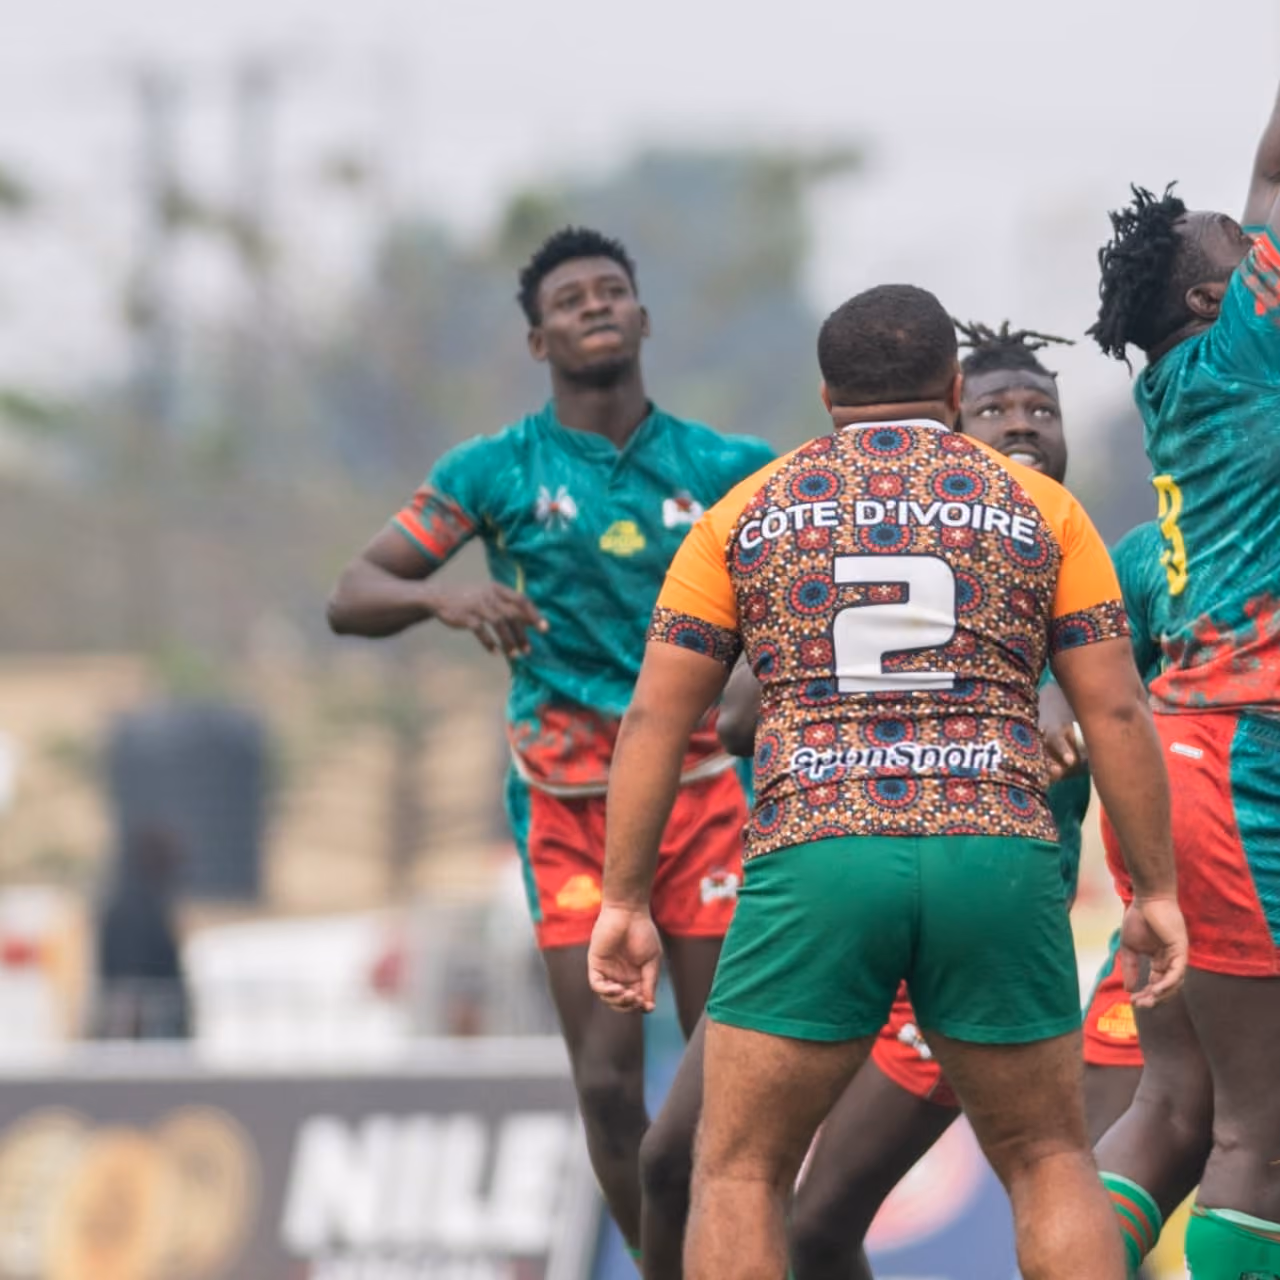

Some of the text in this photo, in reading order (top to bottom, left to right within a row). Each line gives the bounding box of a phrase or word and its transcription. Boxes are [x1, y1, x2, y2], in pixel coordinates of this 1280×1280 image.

[739, 500, 1038, 550] CÔTE D'IVOIRE
[833, 555, 956, 693] 2
